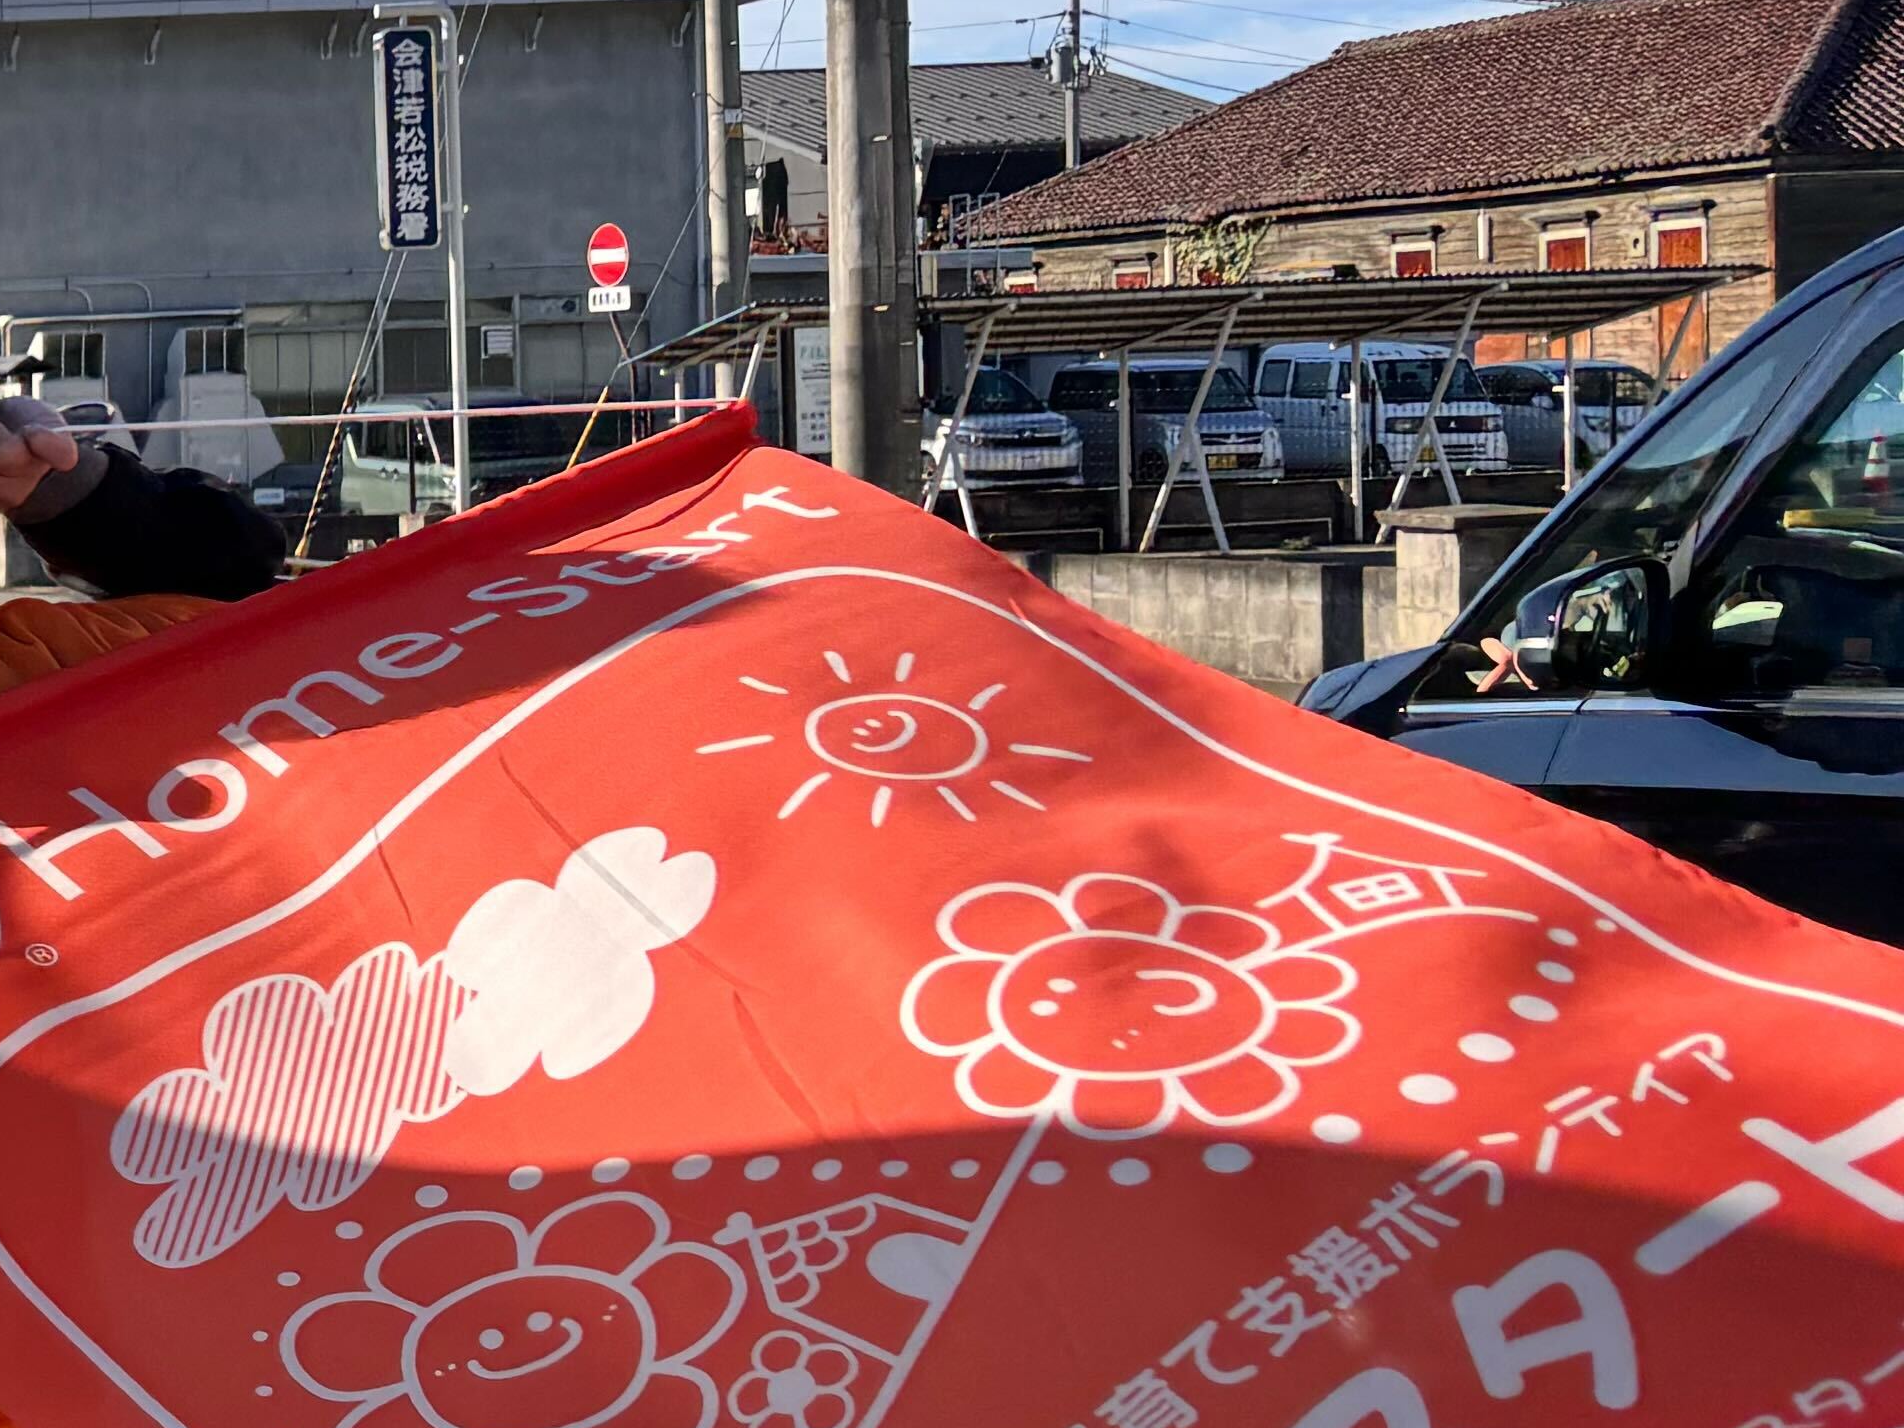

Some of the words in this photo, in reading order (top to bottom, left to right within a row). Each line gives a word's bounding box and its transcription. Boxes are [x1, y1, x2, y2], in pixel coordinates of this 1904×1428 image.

[391, 38, 430, 242] 会津若松税務署
